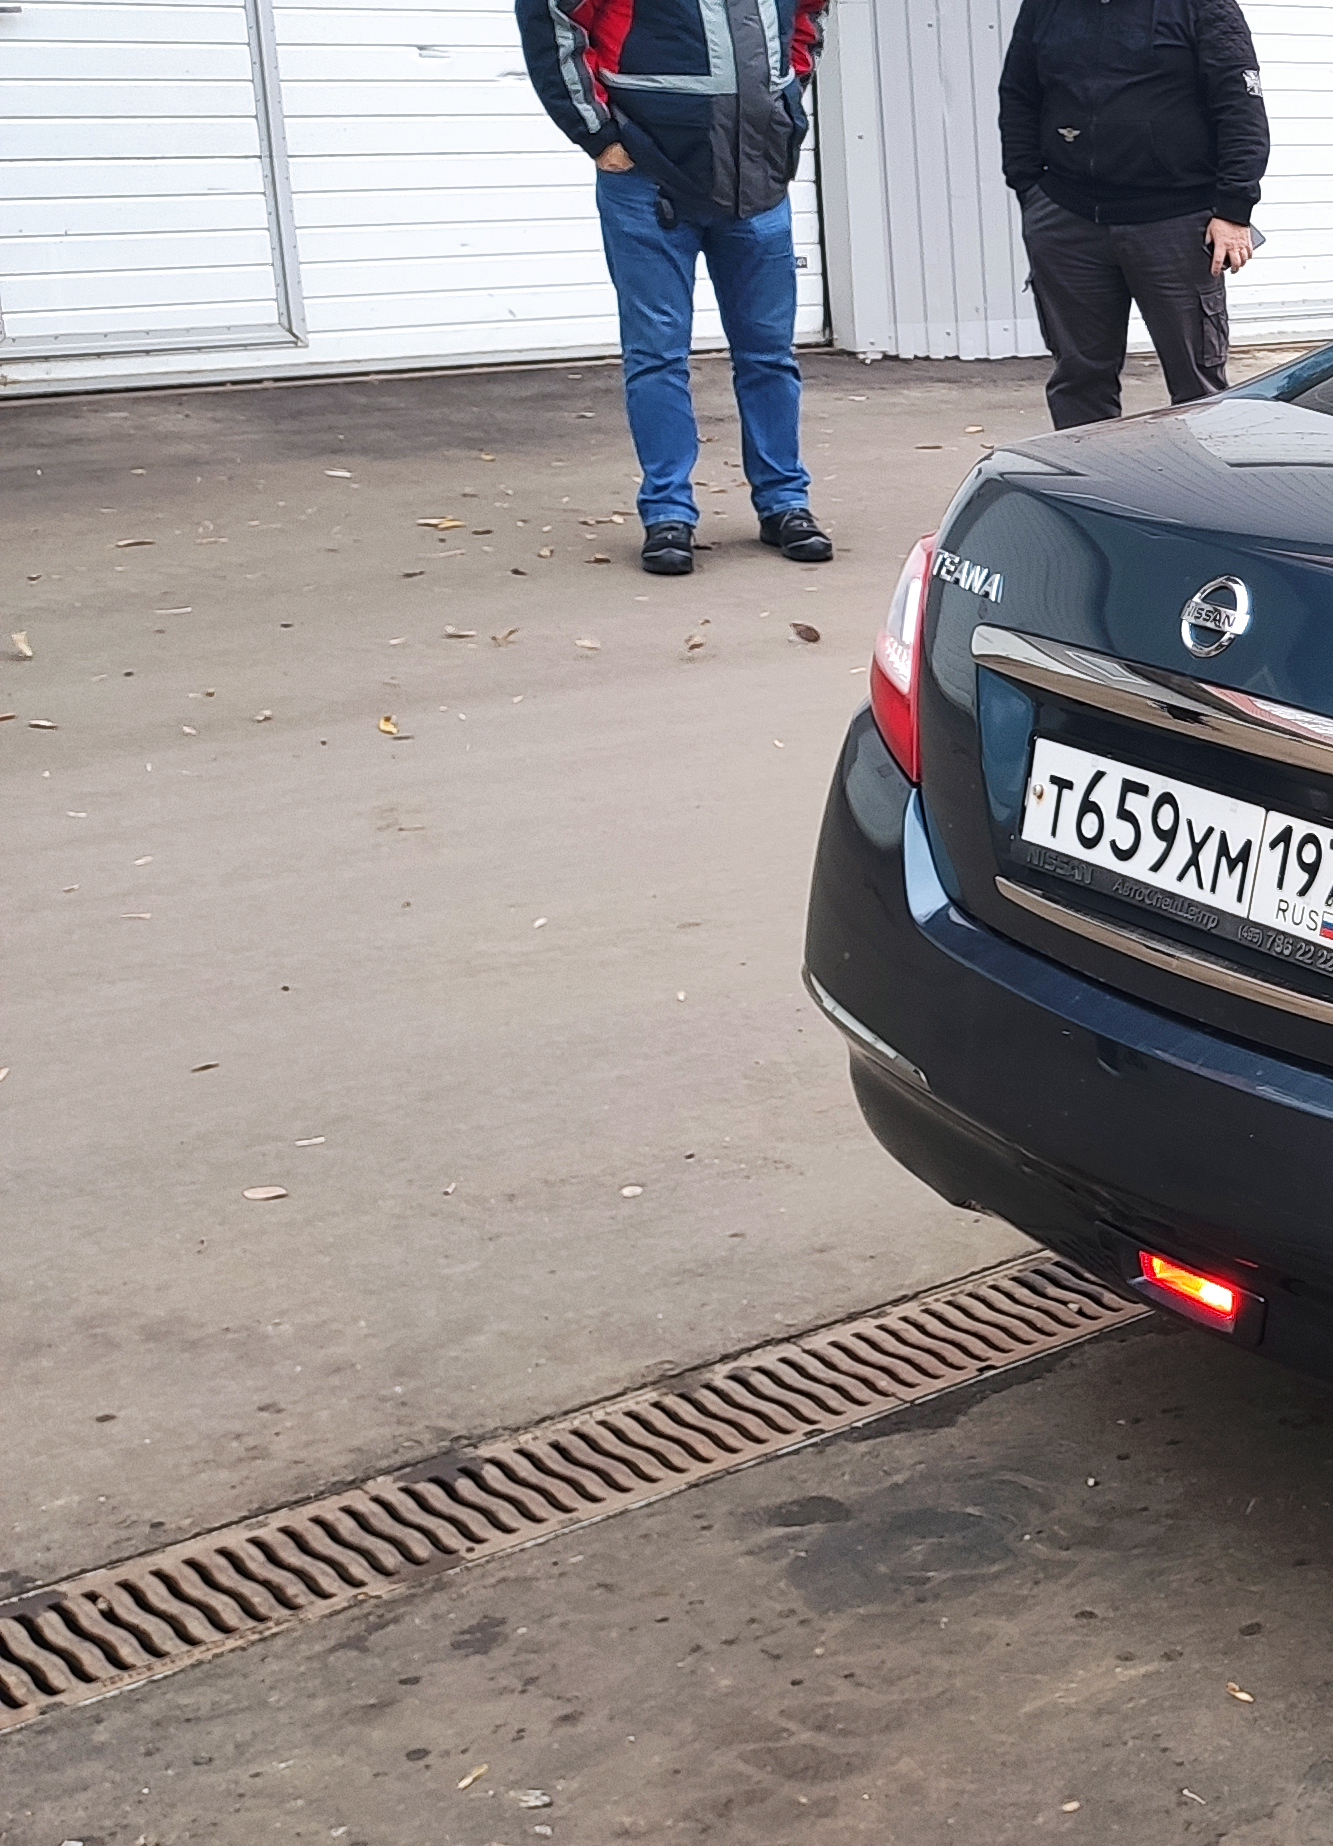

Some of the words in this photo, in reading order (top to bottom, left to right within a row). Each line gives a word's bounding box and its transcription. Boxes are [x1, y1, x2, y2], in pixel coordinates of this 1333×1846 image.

[932, 548, 1004, 604] TEANA
[1185, 602, 1237, 629] NISSAN
[1026, 849, 1094, 885] NISSAN
[1275, 898, 1320, 932] RUS
[1238, 924, 1264, 948] (495)
[1265, 930, 1294, 957] 786
[1295, 941, 1316, 966] 22
